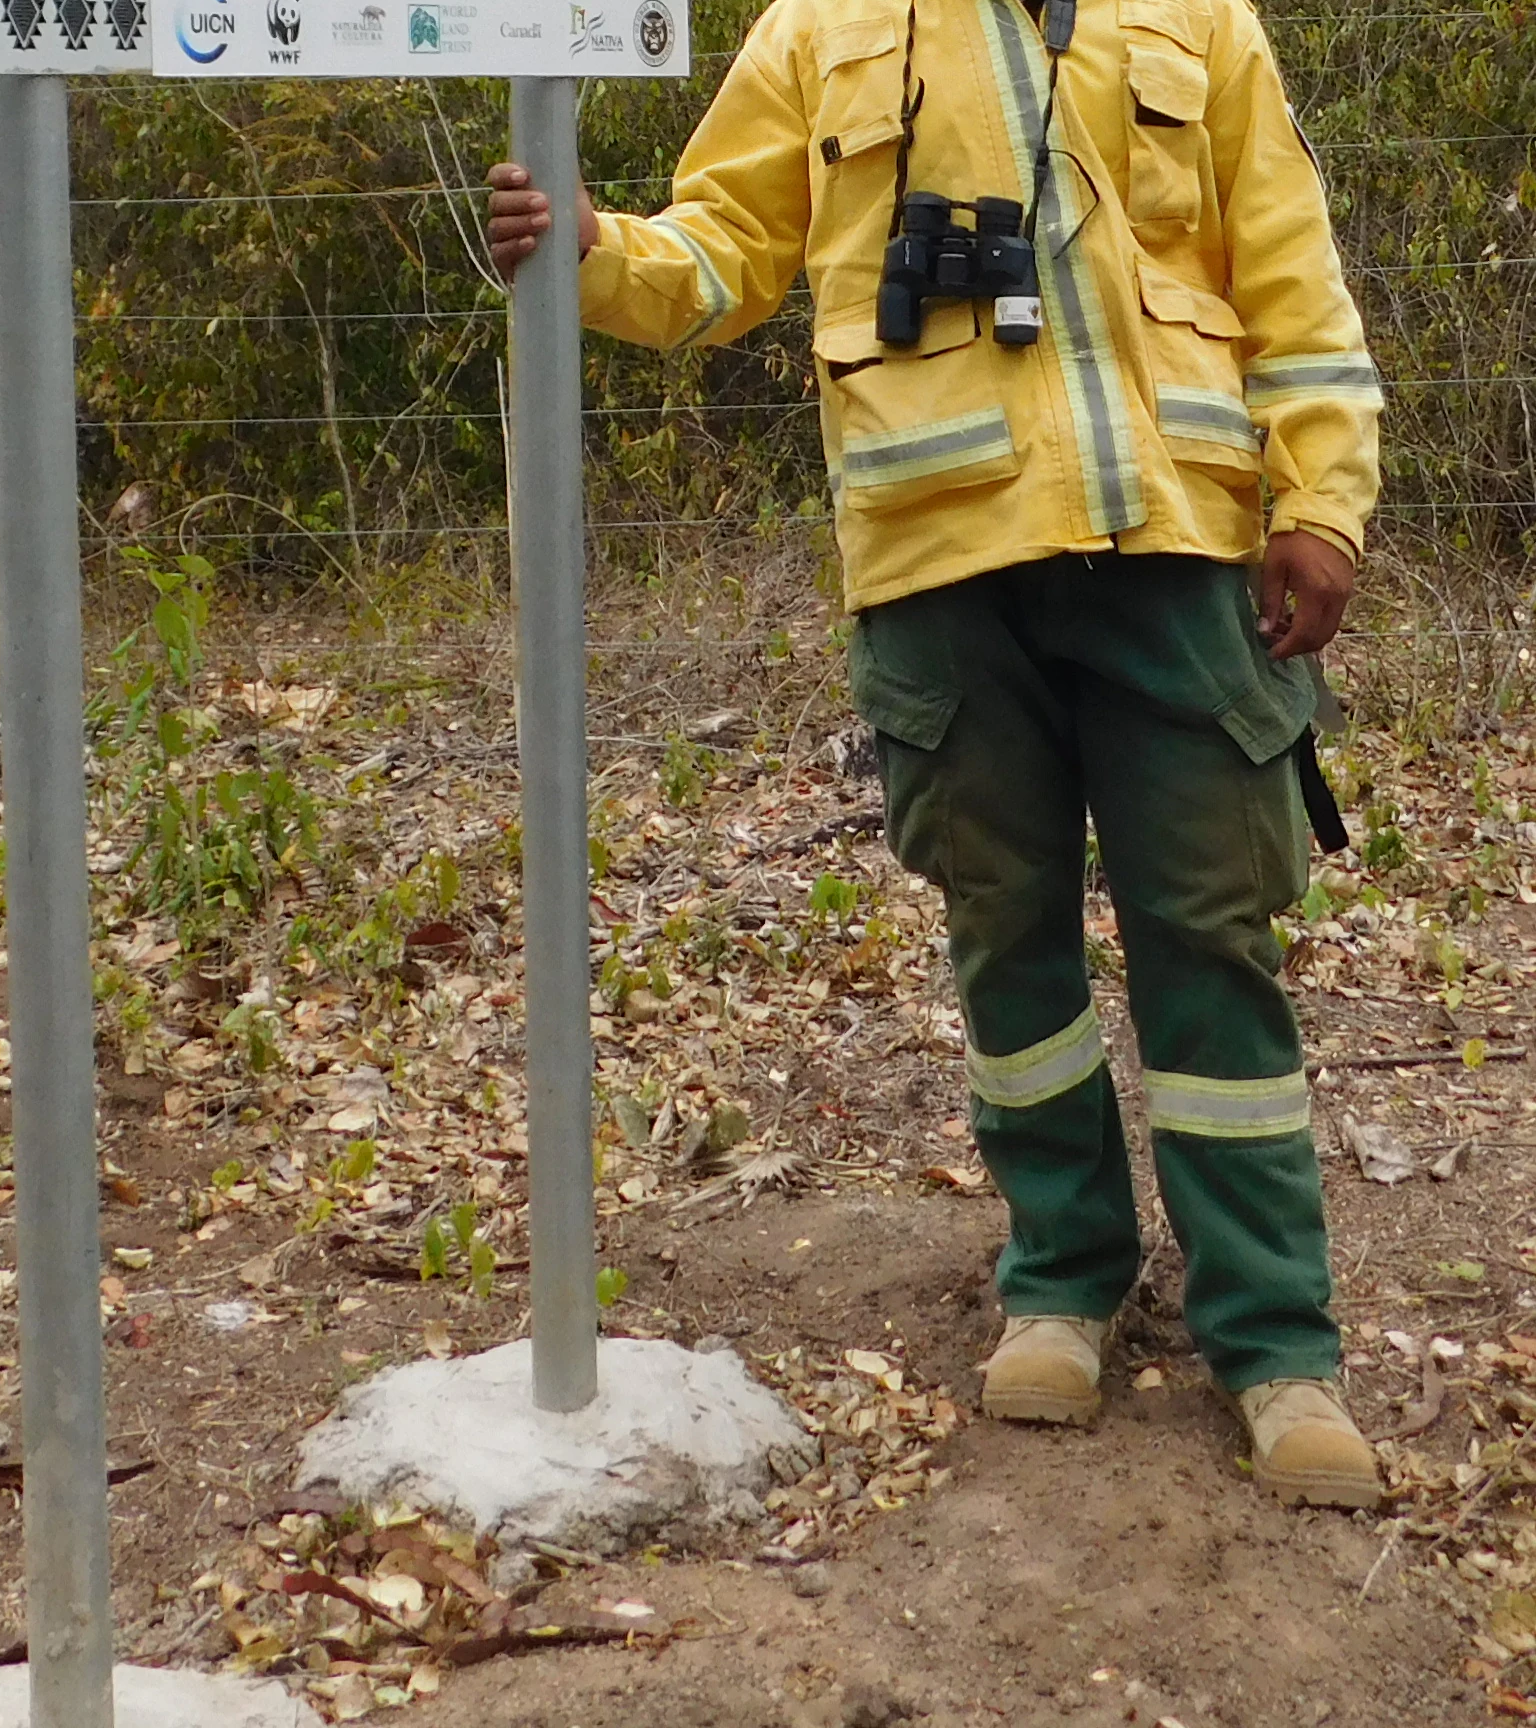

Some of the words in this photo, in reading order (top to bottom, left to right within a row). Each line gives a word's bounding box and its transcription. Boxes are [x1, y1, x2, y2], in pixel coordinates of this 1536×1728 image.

[441, 6, 478, 18] WORLD
[190, 13, 235, 34] UICN
[441, 24, 470, 36] LAND
[441, 41, 473, 53] TRUST
[591, 35, 624, 47] NATIVA
[268, 50, 301, 65] WWF
